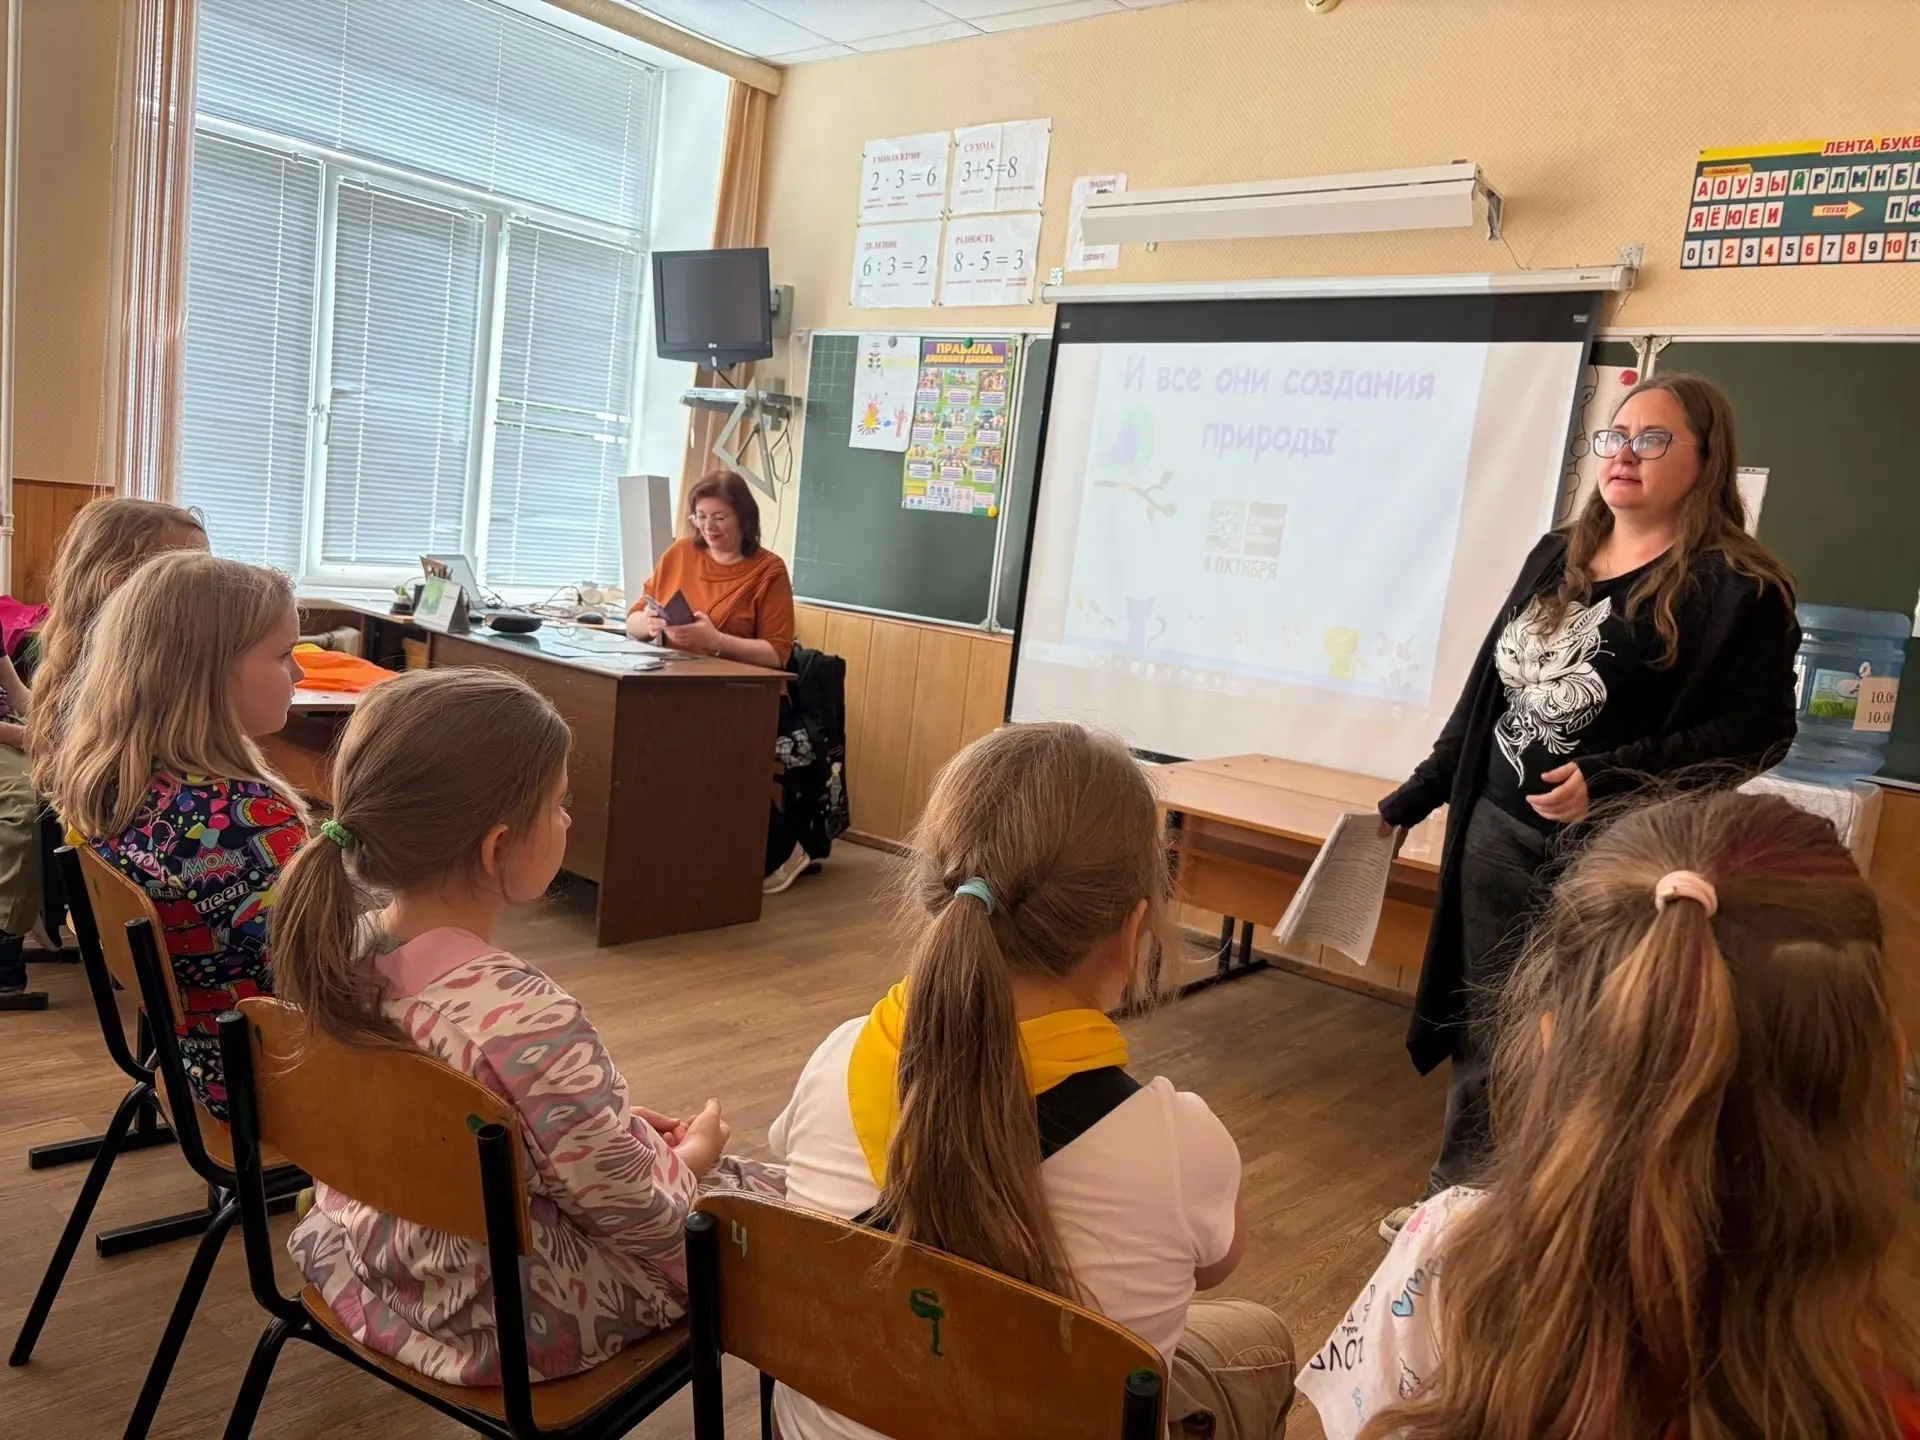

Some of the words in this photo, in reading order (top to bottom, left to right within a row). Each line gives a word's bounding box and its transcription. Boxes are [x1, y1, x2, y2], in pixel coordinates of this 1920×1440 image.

[964, 141, 995, 152] СУММА
[1824, 139, 1875, 154] ЛЕНТА
[871, 171, 880, 191] 2
[895, 168, 905, 189] 3
[926, 165, 937, 186] 6
[961, 156, 1018, 182] 3+5=8
[1697, 181, 1708, 197] А
[1717, 179, 1727, 195] О
[1736, 178, 1748, 194] У
[1754, 176, 1764, 193] Э
[1770, 175, 1787, 192] Ы
[1792, 170, 1806, 191] Й
[1813, 172, 1826, 190] Р
[1831, 172, 1846, 189] Л
[1851, 170, 1868, 188] М
[1895, 168, 1908, 186] Б
[1692, 212, 1704, 228] Я
[1710, 207, 1721, 226] Ё
[1727, 209, 1743, 226] Ю
[1749, 208, 1759, 224] Е
[1767, 207, 1780, 223] И
[1888, 202, 1902, 219] П
[955, 234, 995, 245] РАЗНОСТЬ
[1687, 247, 1696, 260] 0
[1707, 246, 1714, 259] 1
[1725, 245, 1735, 258] 2
[1745, 244, 1754, 258] 3
[1765, 243, 1774, 257] 4
[1785, 242, 1795, 256] 5
[1805, 242, 1814, 256] 6
[1827, 241, 1836, 255] 7
[1846, 241, 1856, 255] 8
[1868, 240, 1878, 254] 9
[1886, 239, 1902, 253] 10
[862, 256, 872, 277] 6
[887, 256, 896, 275] 3
[917, 255, 928, 274] 2
[954, 252, 964, 273] 8
[979, 250, 991, 271] 5
[1013, 249, 1024, 270] 3
[1123, 356, 1145, 391] И
[1156, 365, 1202, 394] все
[1215, 367, 1270, 396] они
[1284, 366, 1436, 402] создания
[1201, 421, 1339, 462] природы
[1214, 556, 1279, 580] ОКТЯБРЯ
